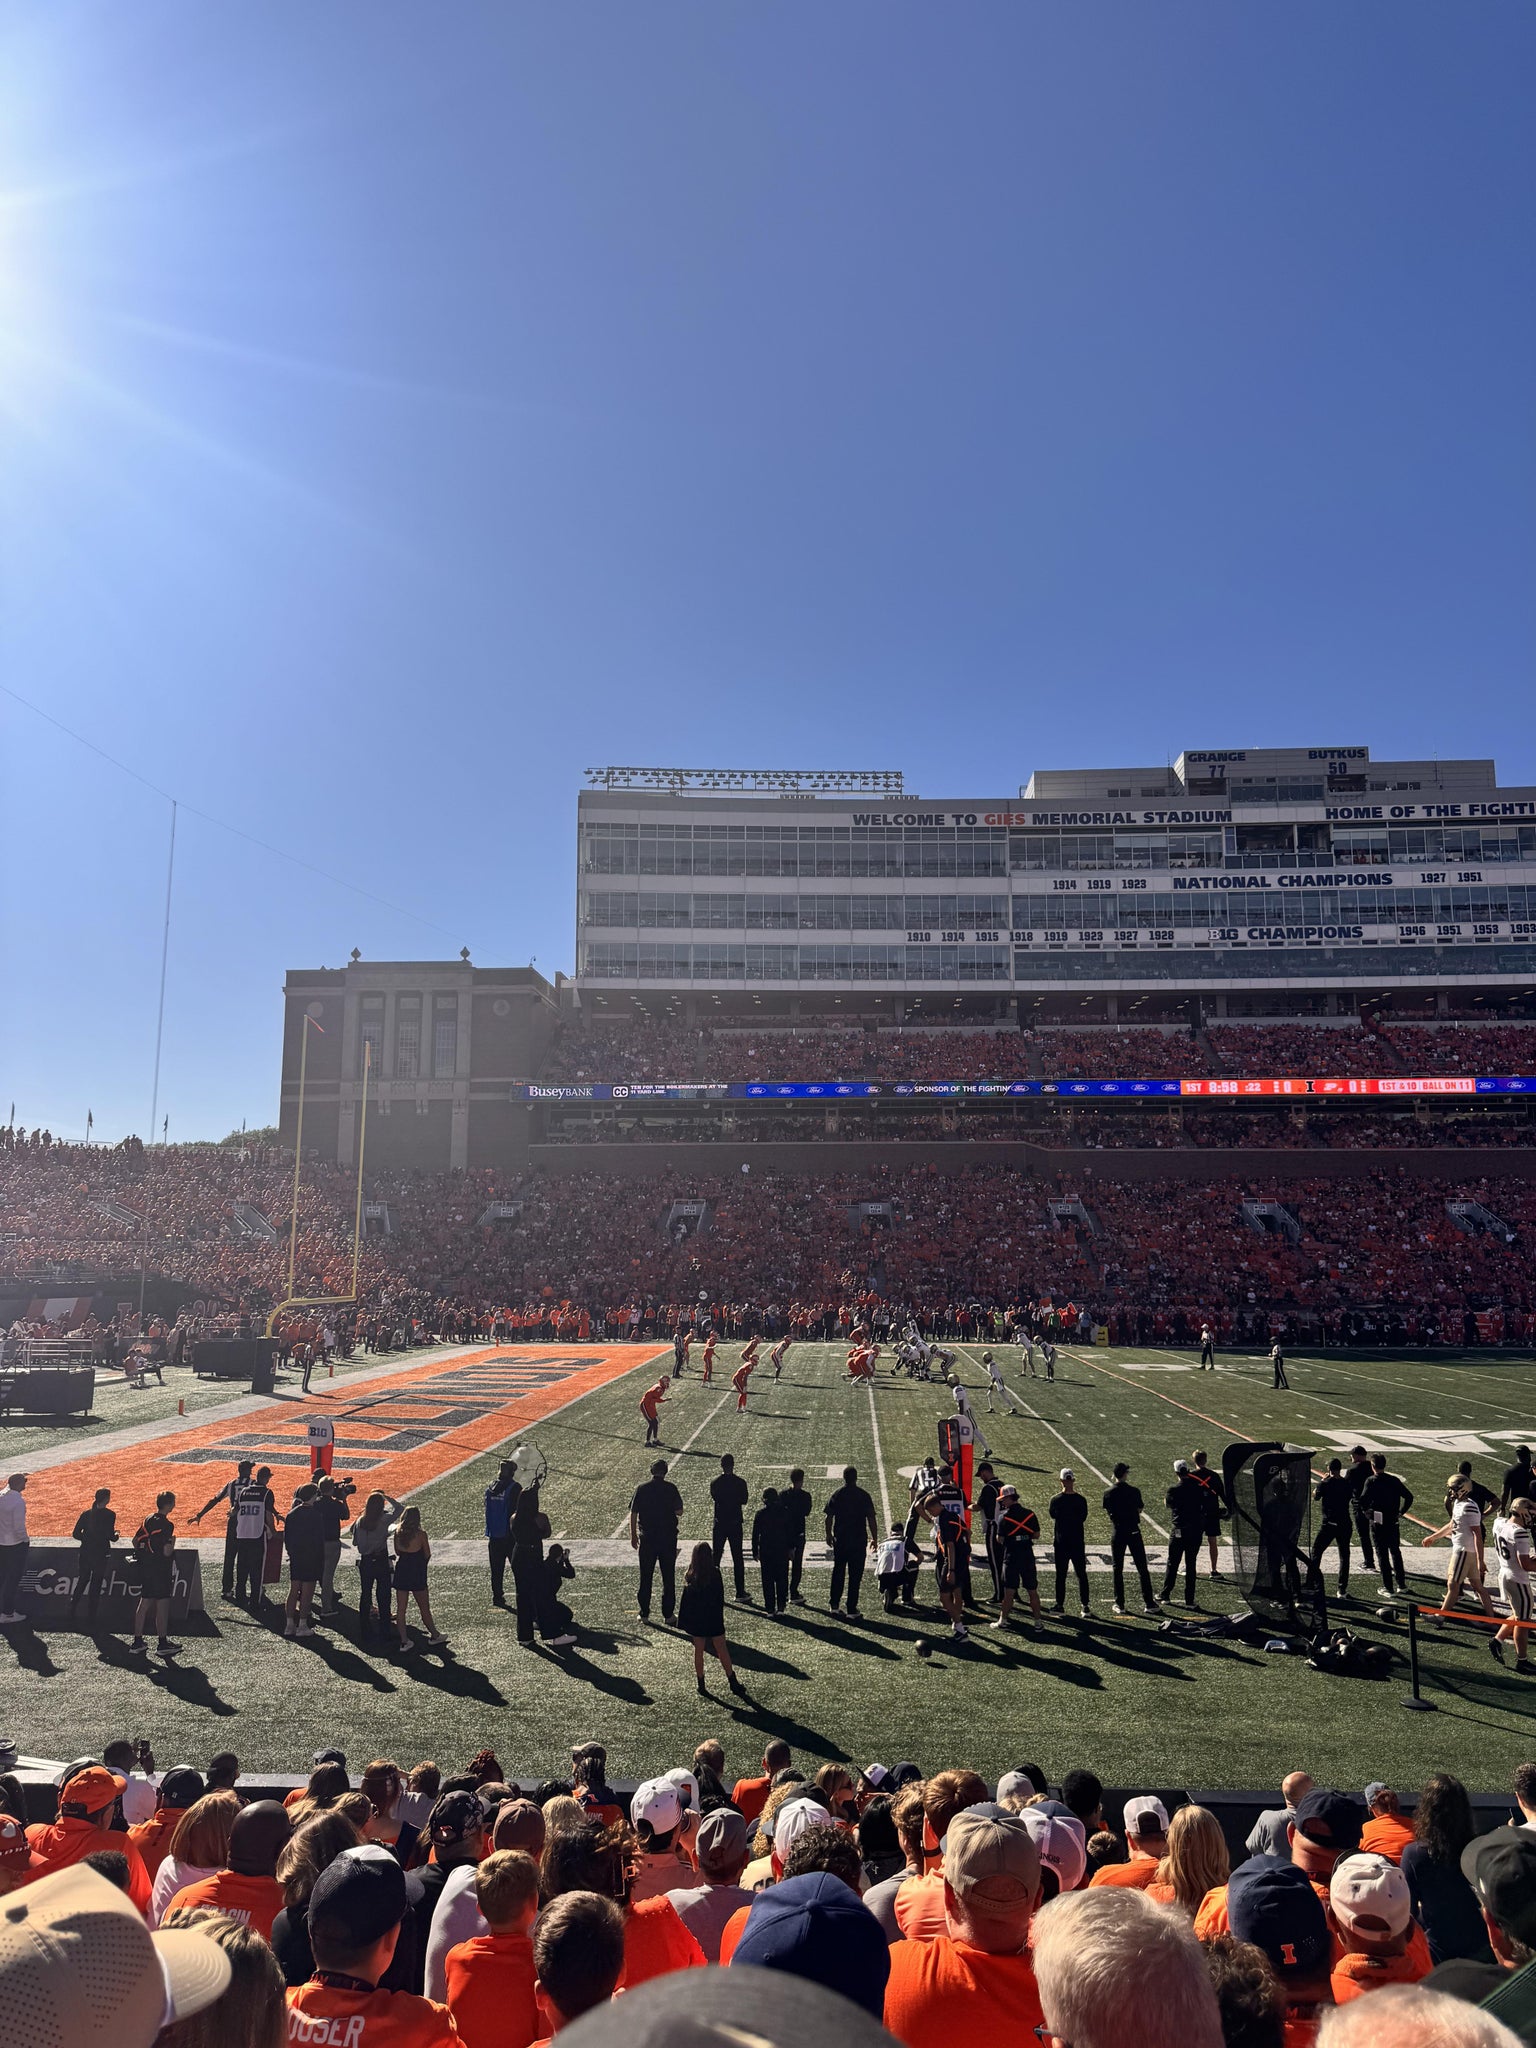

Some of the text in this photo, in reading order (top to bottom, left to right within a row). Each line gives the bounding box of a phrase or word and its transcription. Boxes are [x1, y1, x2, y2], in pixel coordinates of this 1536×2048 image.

[1188, 752, 1246, 762] GRANGE
[1308, 749, 1366, 760] BUTKUS
[1209, 765, 1226, 778] 77
[1328, 762, 1347, 775] 50
[1325, 802, 1535, 820] HOME OF THE FIGHTI
[853, 810, 1232, 826] WELCOME TO GIES MEMORIAL STADIUM
[1053, 878, 1147, 890] 1914 1919 1923
[1173, 873, 1393, 890] NATIONAL CHAMPIONS
[1421, 872, 1483, 884] 1927 1951
[907, 930, 1174, 942] 1910 1914 1915 1918 1919 1923 1927 1928
[1247, 926, 1363, 940] CHAMPIONS
[1399, 925, 1426, 936] 1946
[1437, 925, 1462, 935] 1951
[1473, 924, 1499, 935] 1953
[613, 1086, 628, 1097] CC
[1186, 1083, 1201, 1092] 1ST
[1209, 1082, 1238, 1093] 8:58
[1381, 1082, 1396, 1090] 1ST
[1407, 1082, 1417, 1090] 10
[1422, 1081, 1443, 1090] BALL
[1445, 1081, 1456, 1089] ON
[160, 1356, 607, 1470] ILLINOIS
